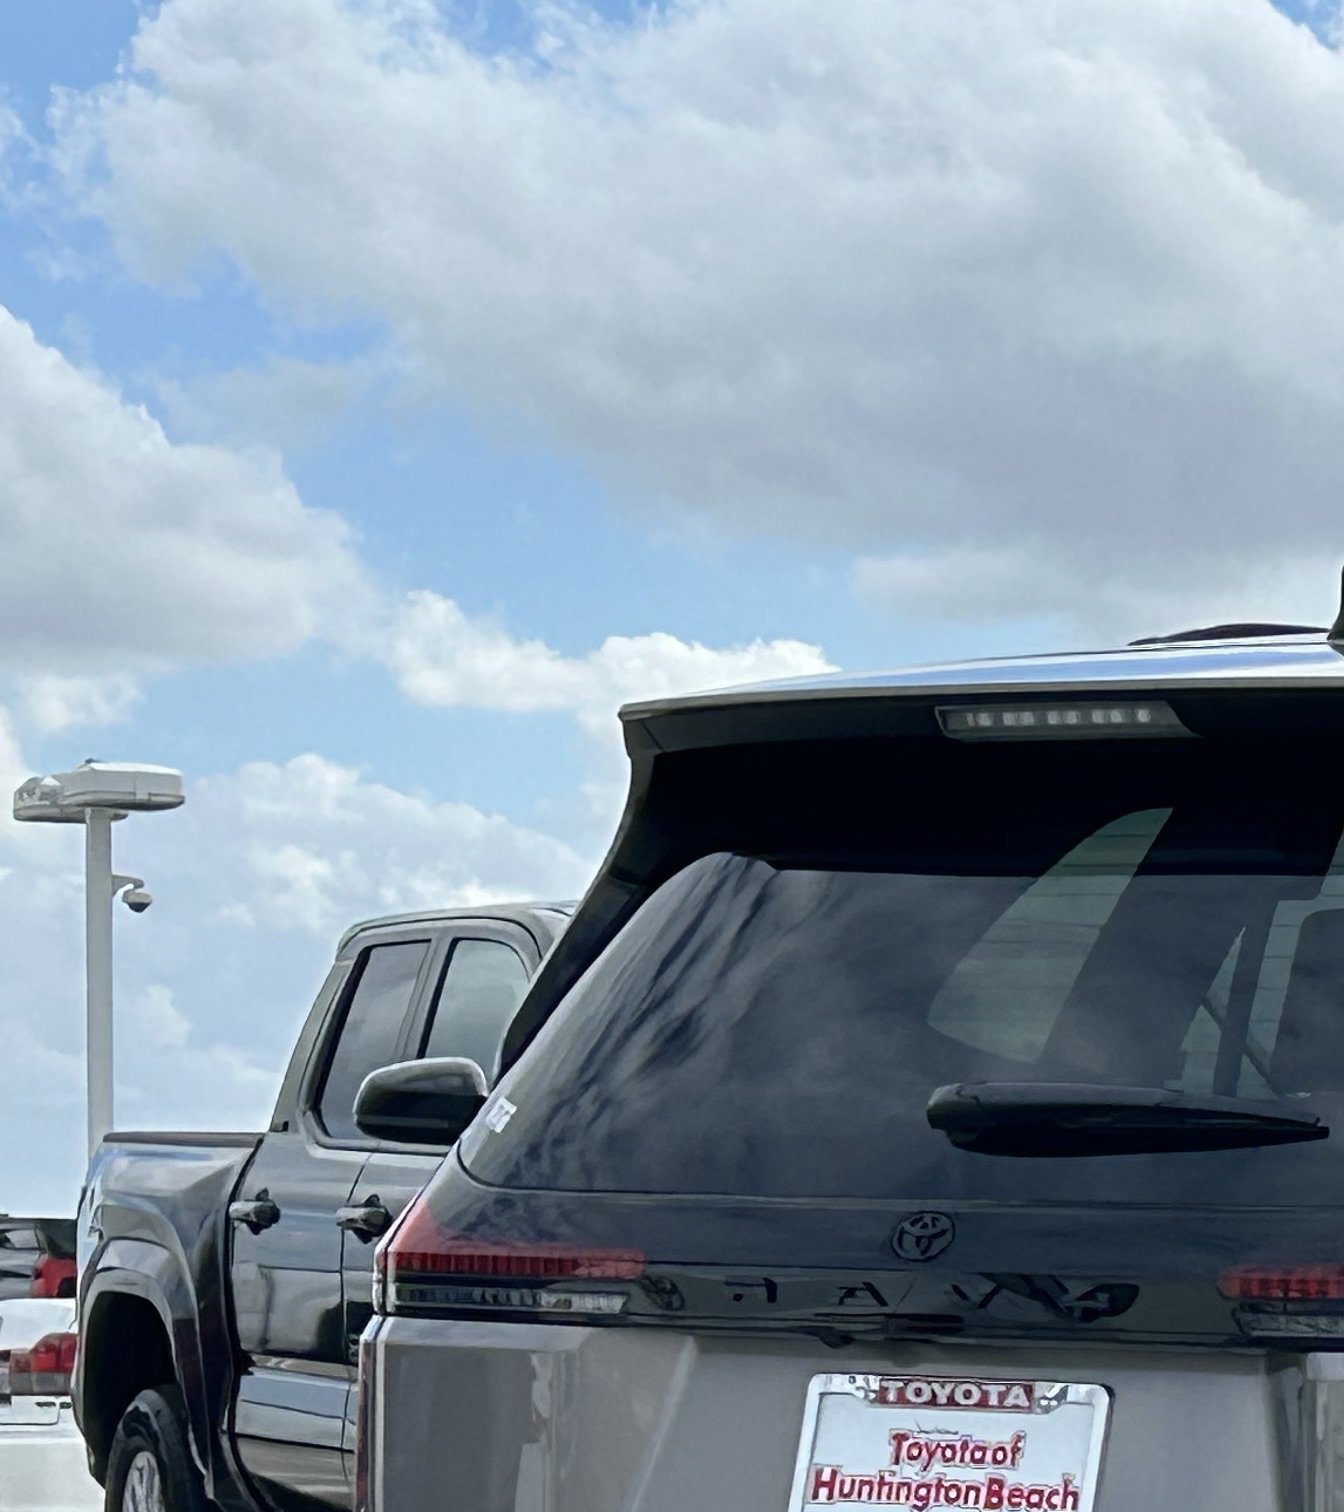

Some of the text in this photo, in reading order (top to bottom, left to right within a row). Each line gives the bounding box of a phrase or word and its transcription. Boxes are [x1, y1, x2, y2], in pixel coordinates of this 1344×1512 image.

[880, 1381, 1032, 1407] TOYOTA
[890, 1430, 1025, 1474] Toyota of
[811, 1467, 1080, 1512] Huntington Beach
